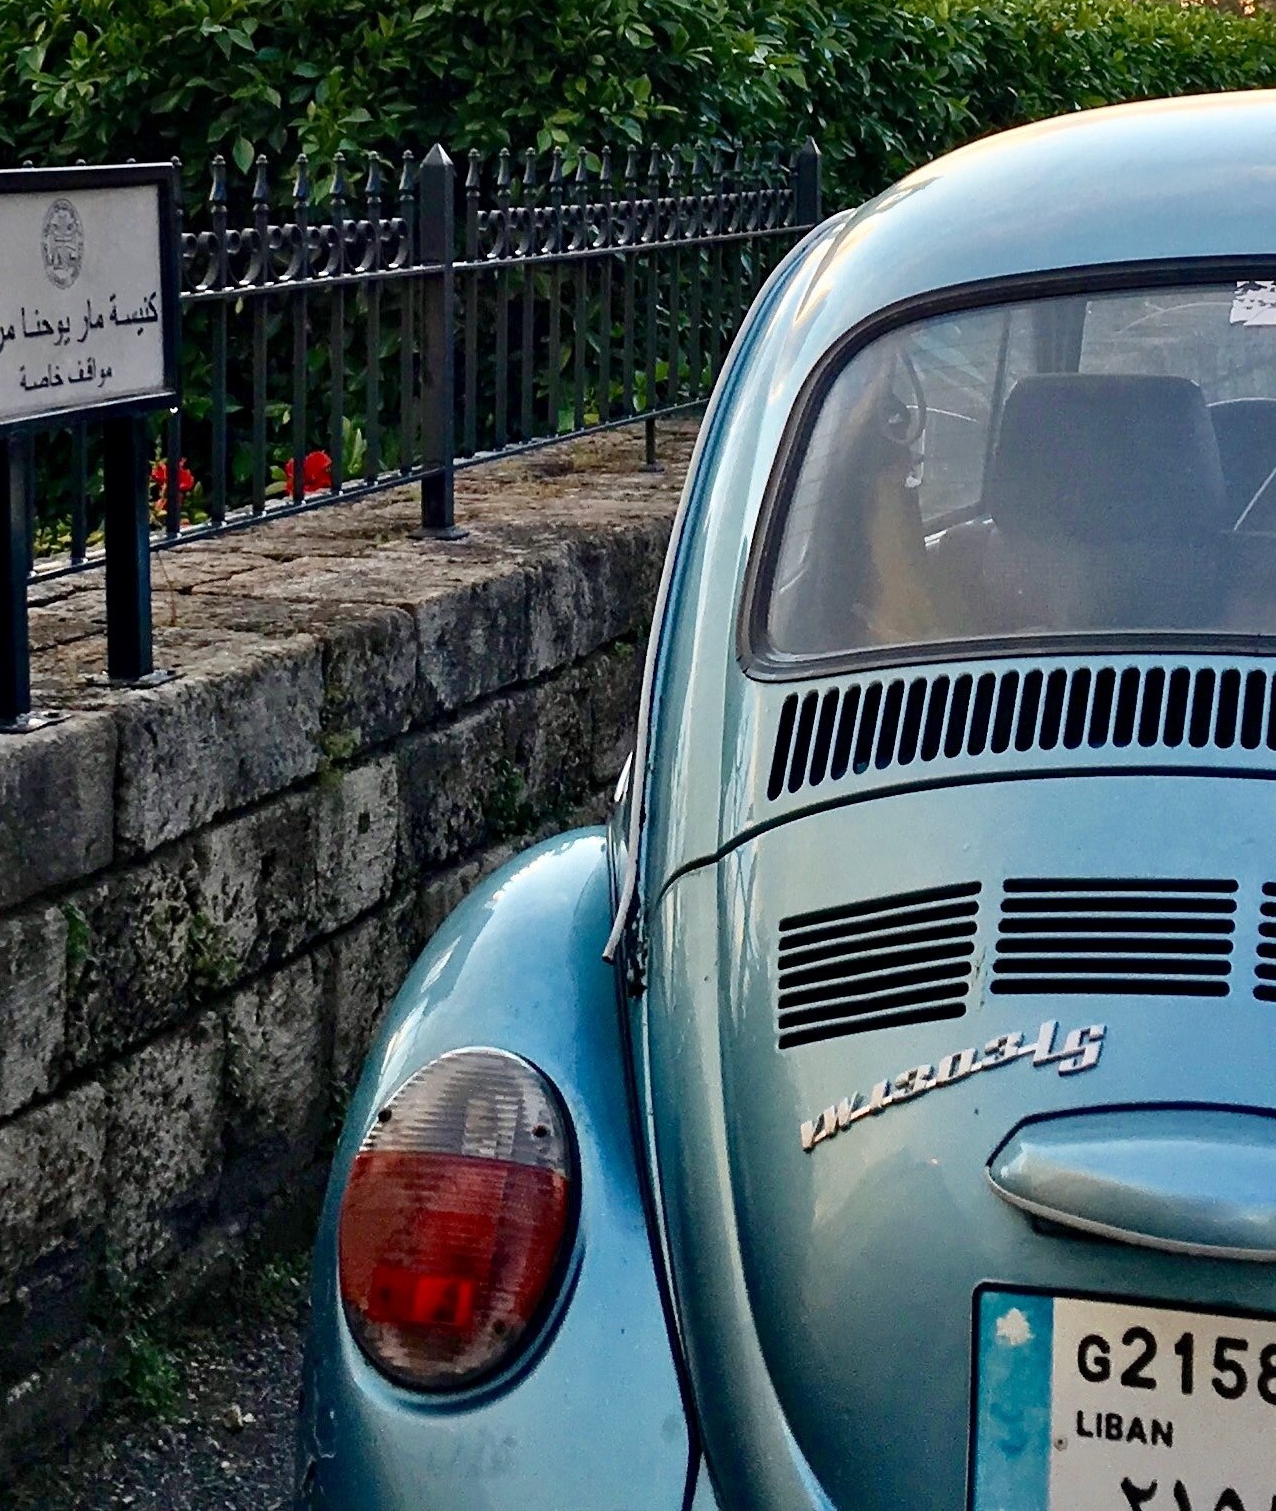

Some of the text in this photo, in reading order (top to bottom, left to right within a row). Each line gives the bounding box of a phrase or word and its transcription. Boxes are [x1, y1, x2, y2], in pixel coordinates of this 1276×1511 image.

[21, 307, 70, 346] يوحنا
[77, 299, 104, 343] مار
[109, 291, 158, 336] كنيسة
[20, 356, 112, 391] مواقف خاصة
[1076, 1410, 1173, 1447] LIBAN
